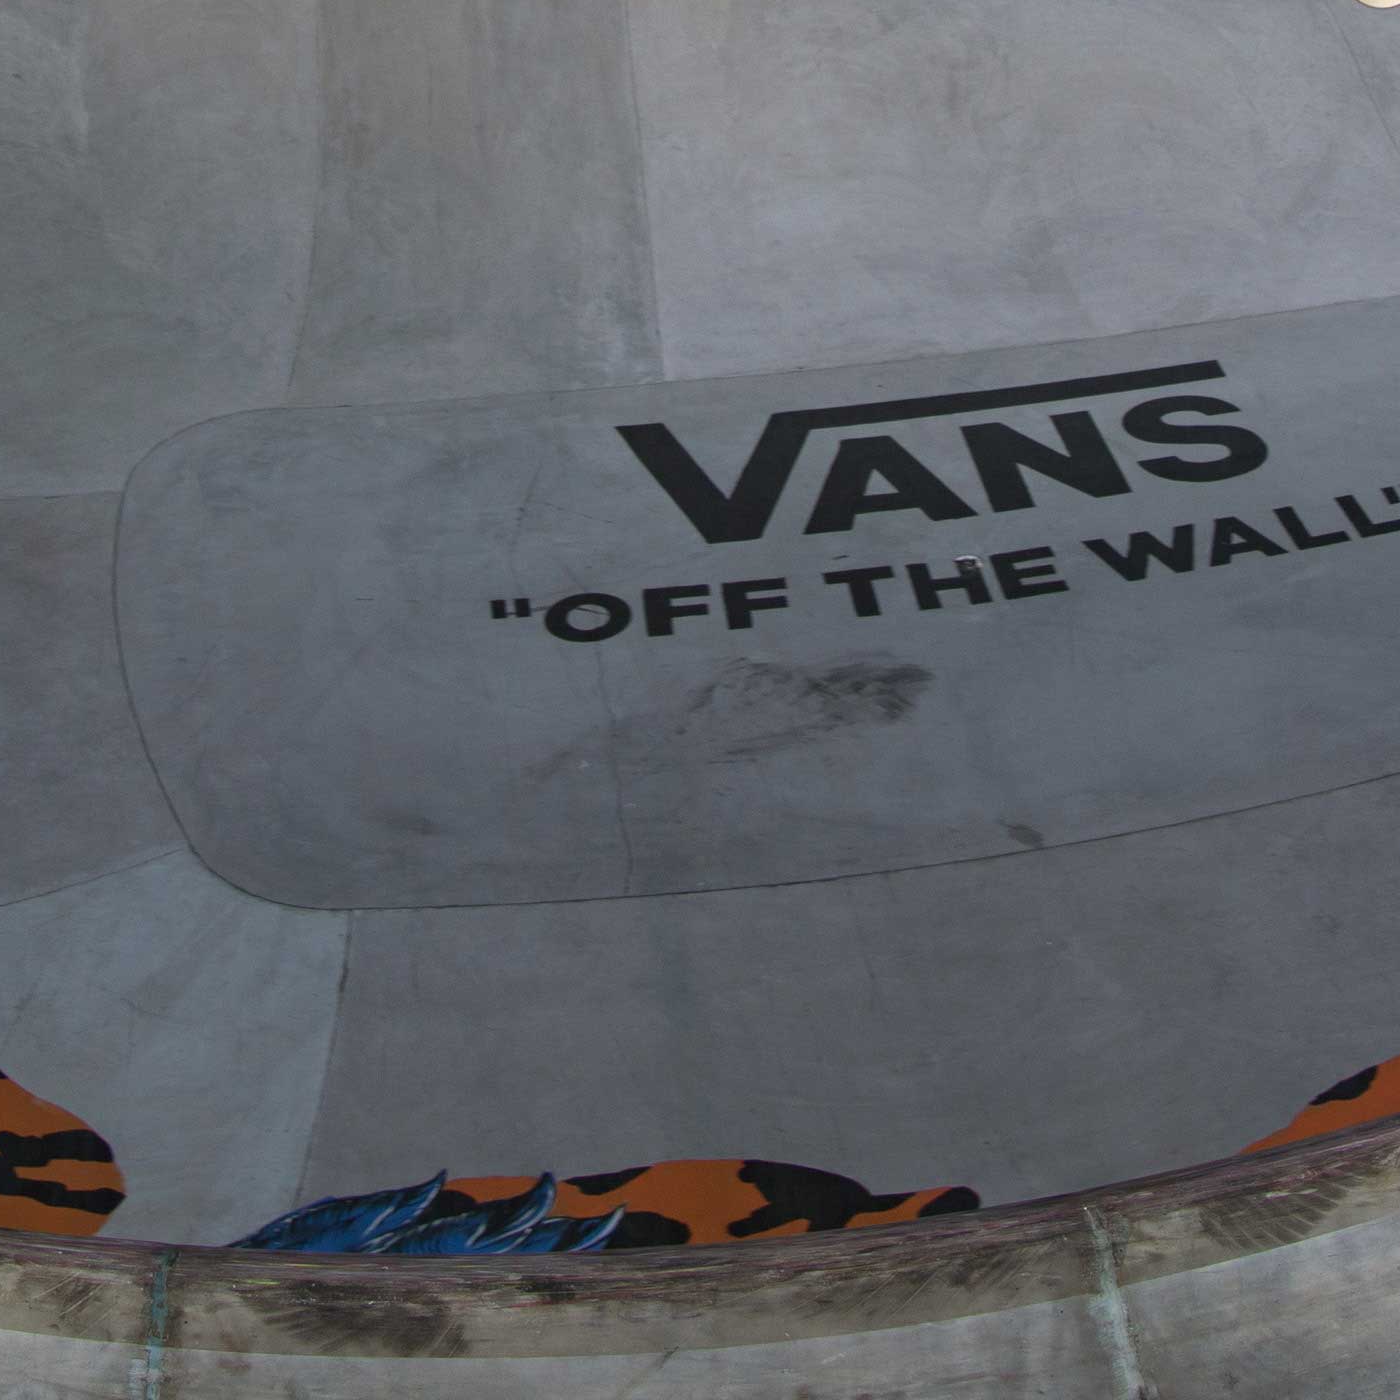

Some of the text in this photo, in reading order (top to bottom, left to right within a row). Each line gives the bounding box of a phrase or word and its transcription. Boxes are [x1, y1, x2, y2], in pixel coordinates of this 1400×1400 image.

[613, 359, 1271, 546] VANS
[488, 579, 790, 644] "OFF
[821, 545, 1070, 618] THE
